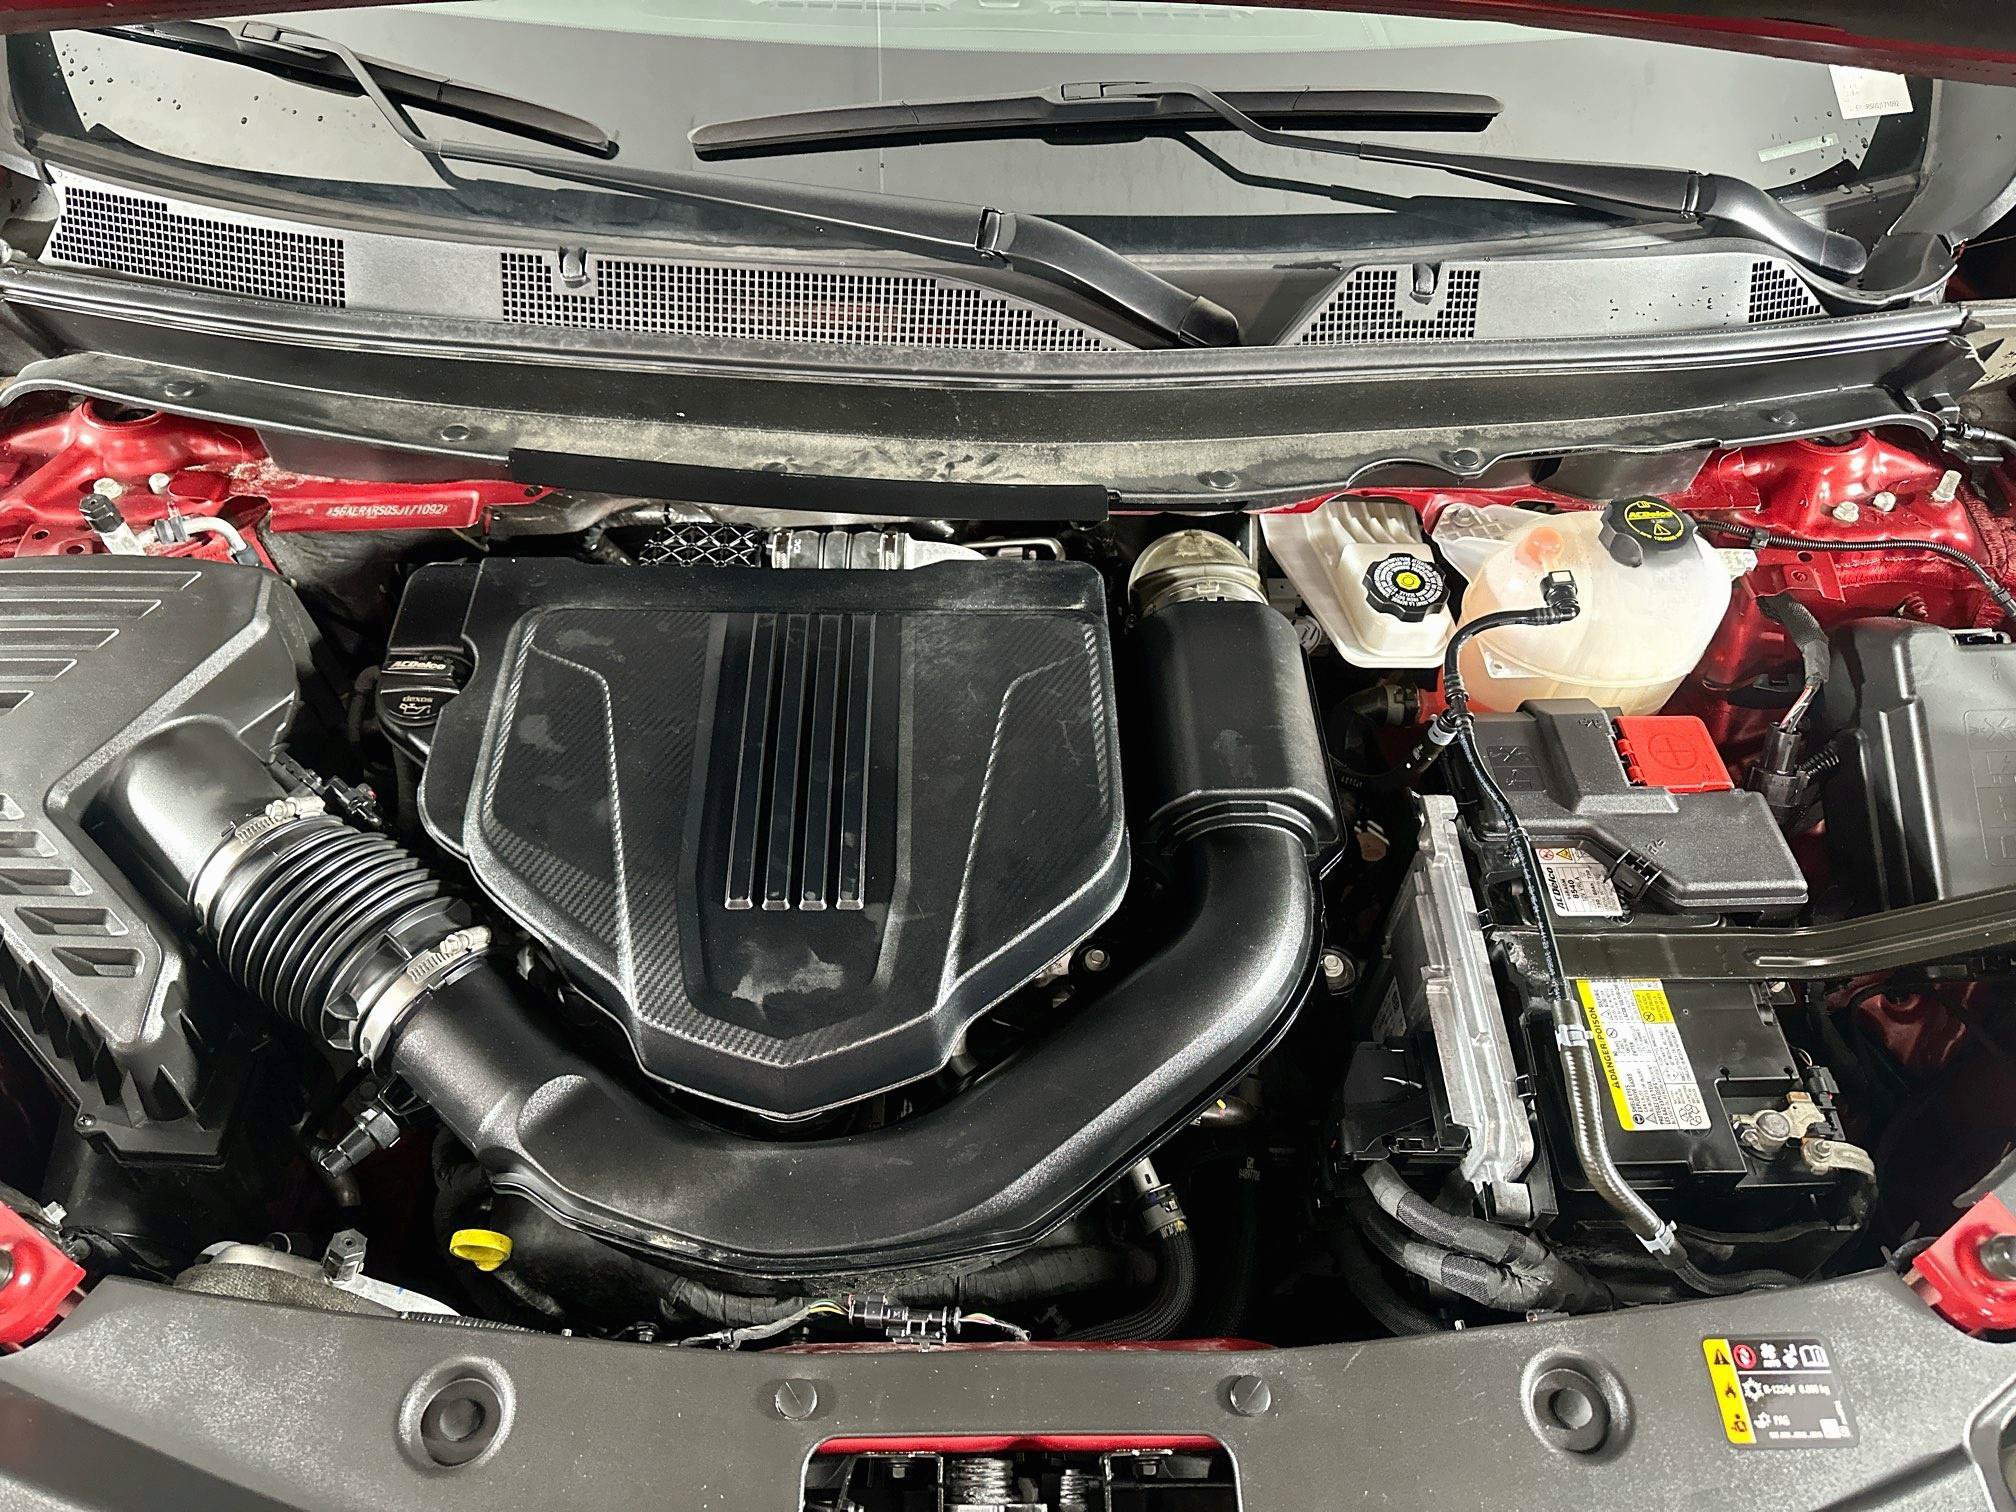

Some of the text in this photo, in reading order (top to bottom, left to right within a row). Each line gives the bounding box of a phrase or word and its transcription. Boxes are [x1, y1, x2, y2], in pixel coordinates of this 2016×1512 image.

[391, 660, 447, 671] ACDelco
[402, 695, 434, 703] dexos
[1546, 867, 1564, 908] ACDelco
